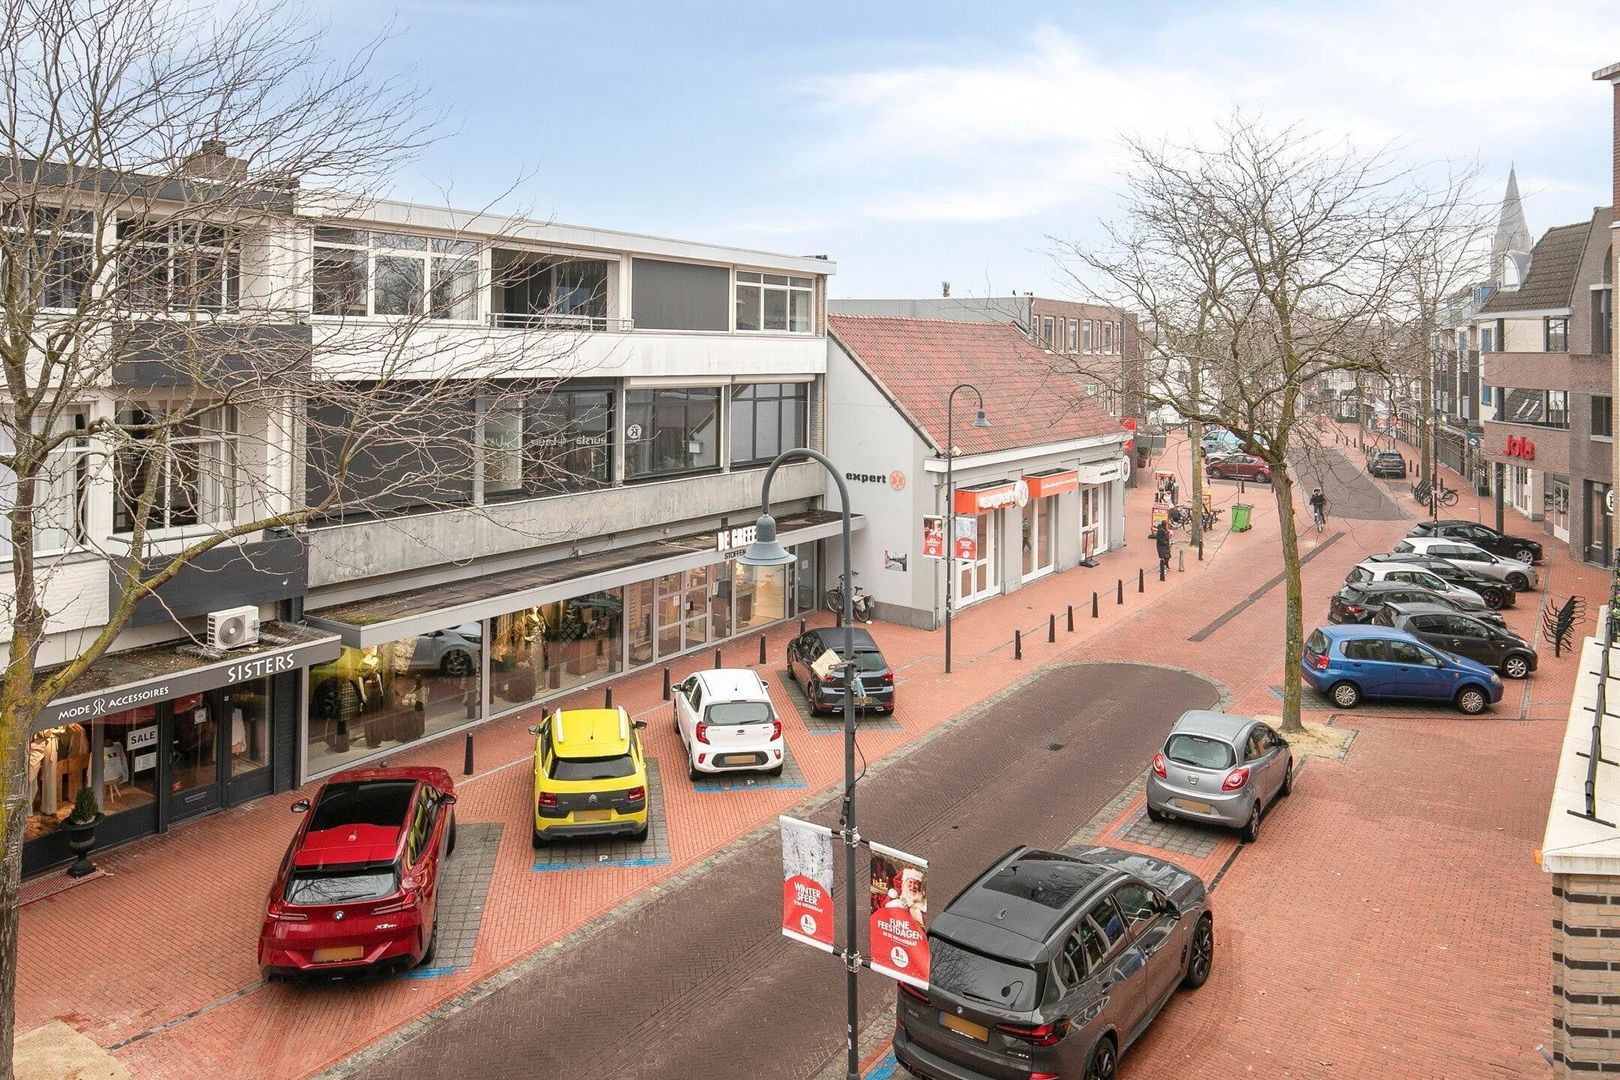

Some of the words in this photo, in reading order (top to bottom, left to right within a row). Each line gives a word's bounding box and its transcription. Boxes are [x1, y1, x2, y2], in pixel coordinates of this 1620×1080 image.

[845, 472, 887, 484] expert
[717, 530, 731, 552] DE
[227, 653, 294, 683] SISTERS
[58, 705, 91, 720] MODE
[107, 686, 169, 708] ACCESSOIRES
[130, 730, 156, 745] SALE
[794, 881, 821, 899] WINTER
[796, 893, 818, 906] SFEER
[877, 920, 923, 941] FEESTDAGEN
